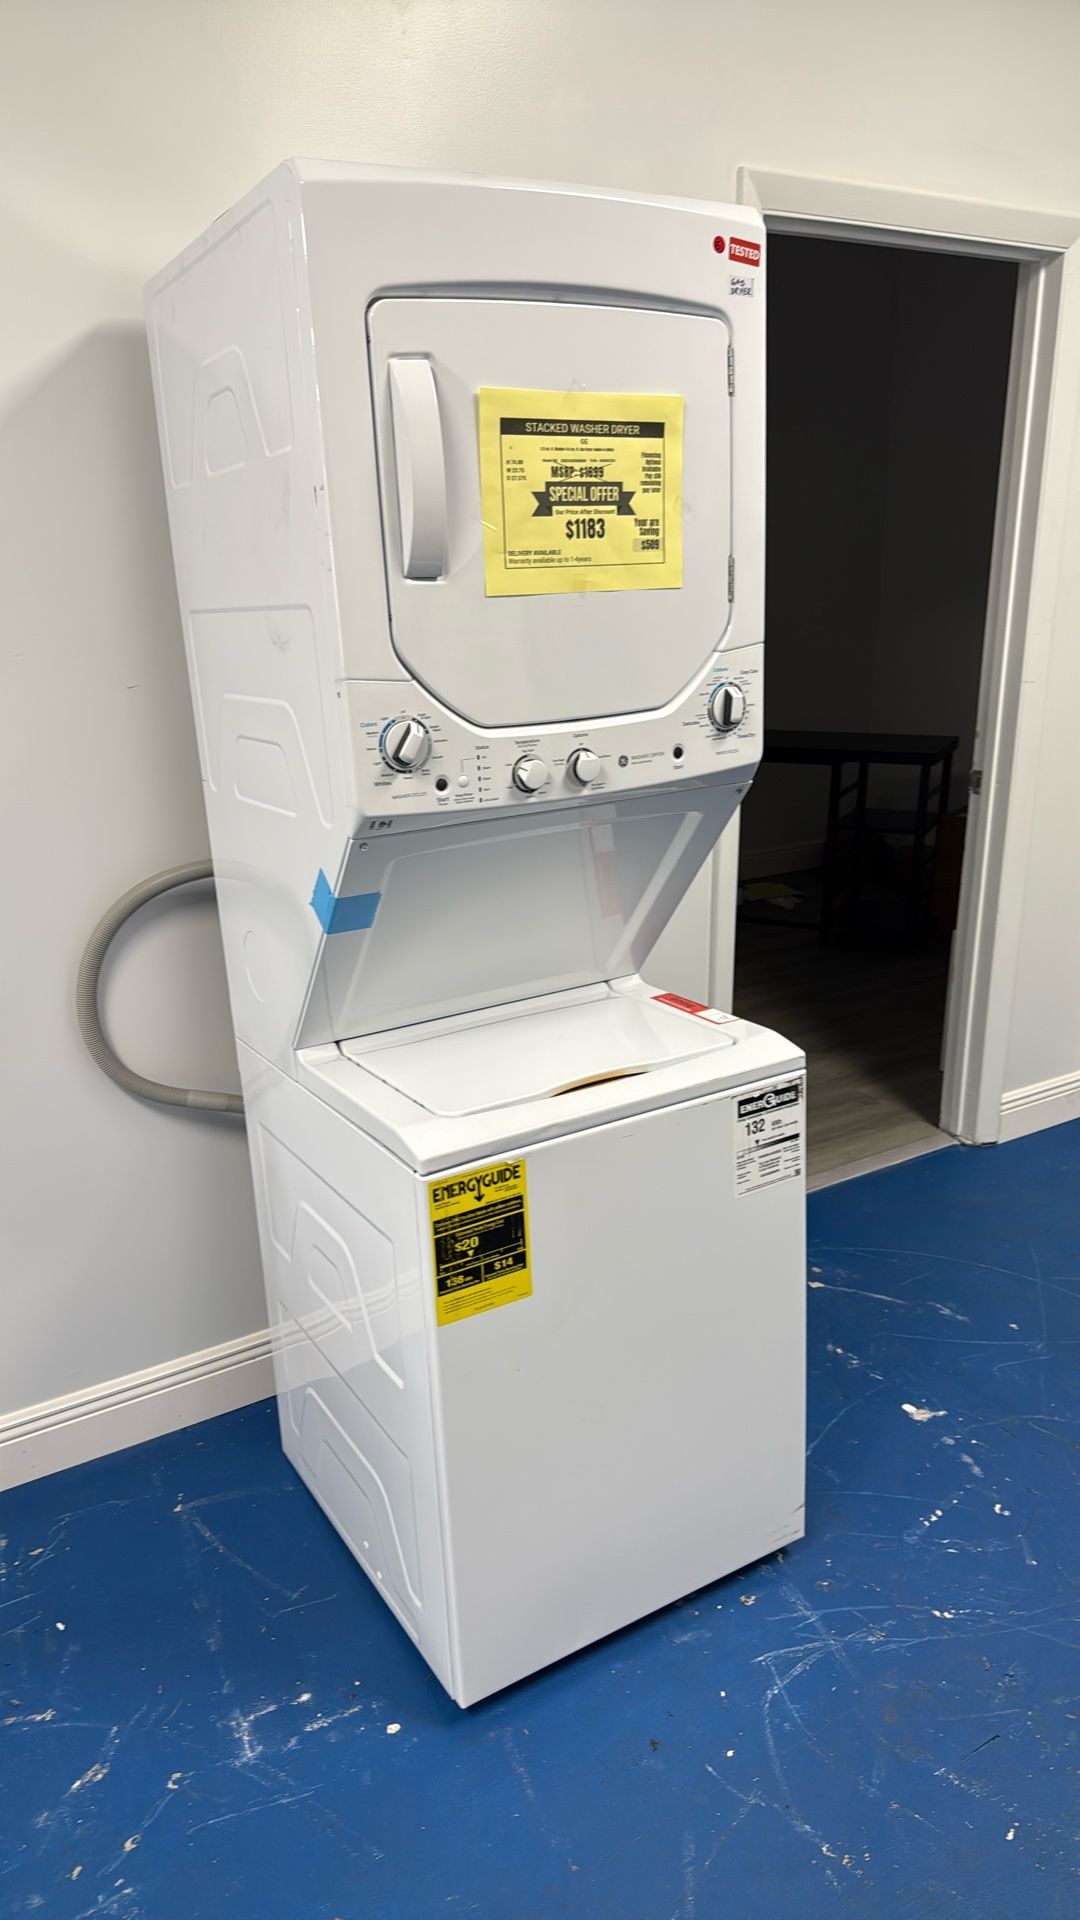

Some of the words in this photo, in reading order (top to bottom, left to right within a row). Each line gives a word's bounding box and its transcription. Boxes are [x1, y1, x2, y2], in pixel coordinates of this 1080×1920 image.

[730, 244, 760, 260] TESTED
[525, 422, 568, 433] STACKED
[569, 423, 610, 434] WASHER
[610, 424, 641, 435] DRYER
[549, 486, 588, 502] SPECIAL
[590, 486, 619, 502] OFFER
[566, 518, 605, 540] $1183
[639, 527, 659, 537] Saving
[745, 1118, 766, 1136] 132
[432, 1164, 521, 1203] ENERGYGUIDE
[454, 1236, 480, 1252] $20
[494, 1257, 514, 1270] $14
[445, 1275, 465, 1287] 138
